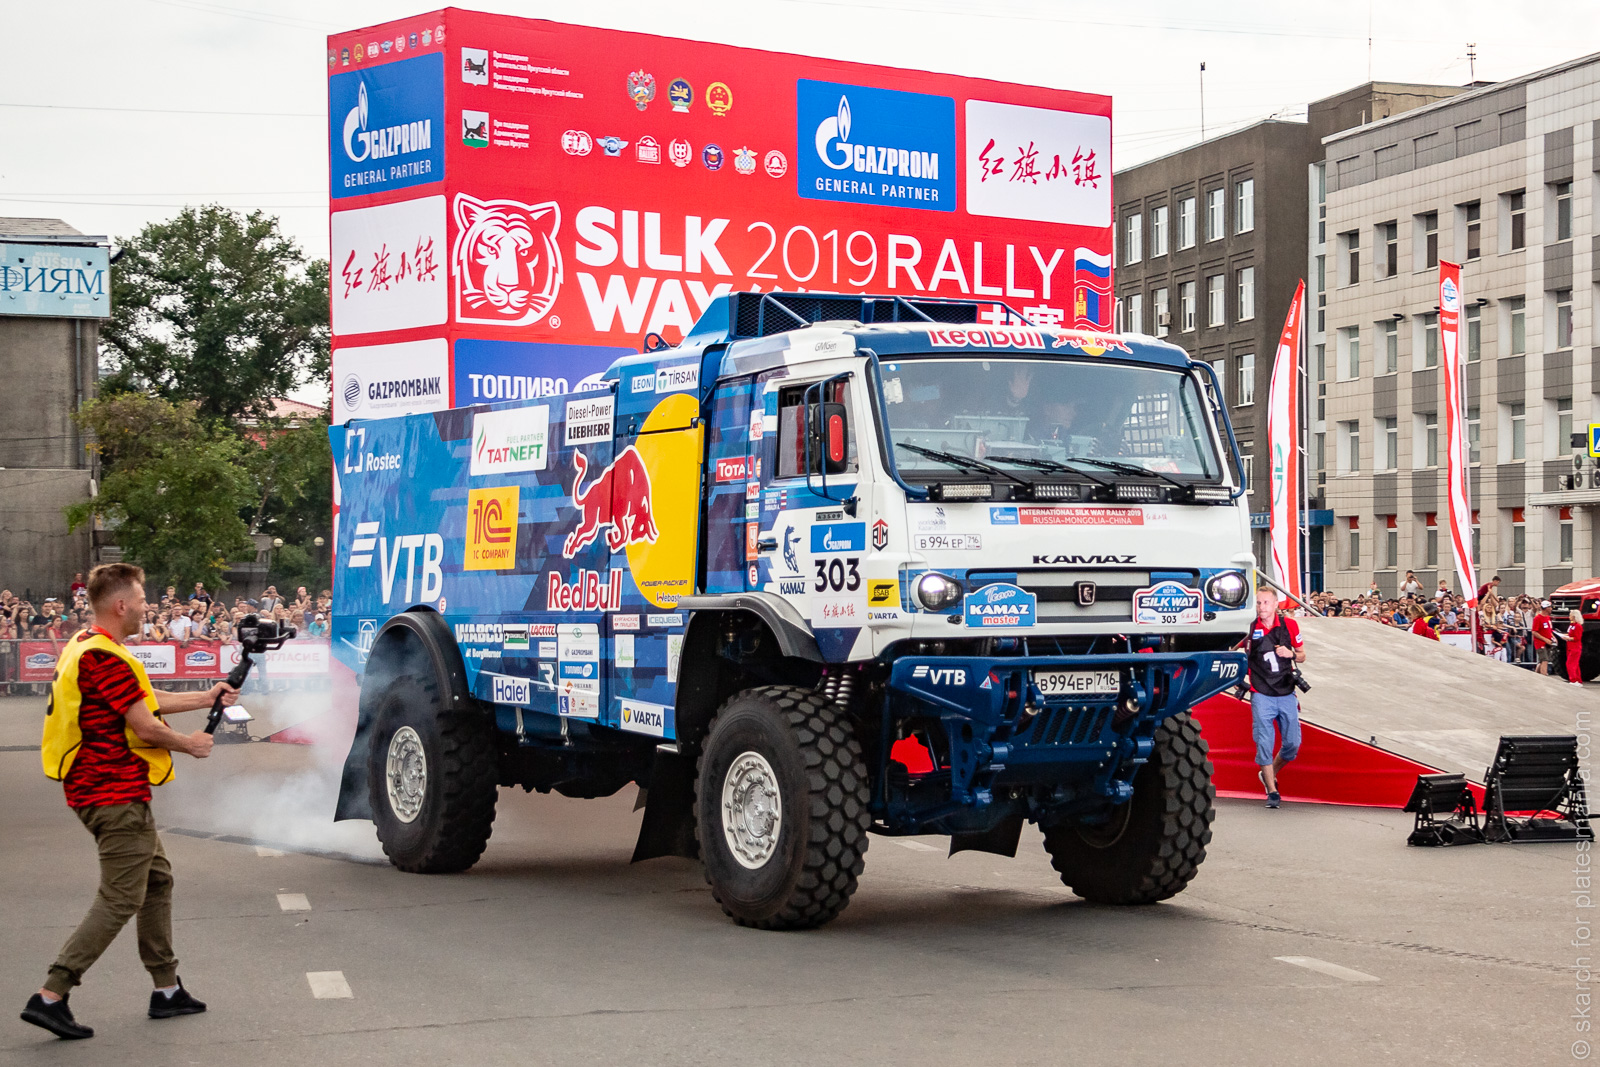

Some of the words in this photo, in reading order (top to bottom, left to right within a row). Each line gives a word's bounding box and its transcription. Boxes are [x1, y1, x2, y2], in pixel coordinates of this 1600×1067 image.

[370, 120, 430, 160] GAZPROM
[854, 149, 939, 180] GAZPROM
[979, 138, 1102, 189] 红旗小镇
[344, 173, 386, 188] GENERAL
[391, 161, 431, 181] PARTNER
[816, 178, 875, 196] GENERAL
[882, 184, 939, 202] PARTNER
[575, 206, 733, 276] SILK
[747, 222, 877, 286] 2019
[888, 234, 1065, 300] RALLY
[368, 377, 441, 400] GAZPROMBANK
[468, 373, 569, 400] ТОПЛИВО
[633, 378, 654, 390] LEONI
[568, 403, 612, 420] Diesel-Power
[568, 423, 610, 440] LIEBHERR
[487, 444, 543, 464] TATNEFT
[366, 456, 402, 476] Rostec
[718, 463, 752, 478] TOTAL
[929, 536, 949, 547] 994
[481, 549, 509, 559] COMPANY
[1033, 555, 1136, 564] KAMAZ
[380, 533, 444, 604] VTB
[814, 558, 861, 592] 303
[780, 582, 806, 594] KAMAZ
[874, 589, 890, 597] ESAB
[985, 586, 1016, 603] Team
[970, 604, 1029, 615] KAMAZ
[1141, 597, 1172, 607] SILK
[1172, 597, 1196, 607] WAY
[984, 616, 1019, 624] master
[1162, 615, 1177, 623] 303
[455, 624, 502, 643] WABCO
[1263, 651, 1279, 672] 1
[929, 669, 966, 686] VTB
[1096, 673, 1116, 685] 716
[1219, 663, 1239, 680] VTB
[495, 679, 527, 702] Haier
[633, 710, 662, 724] VARTA
